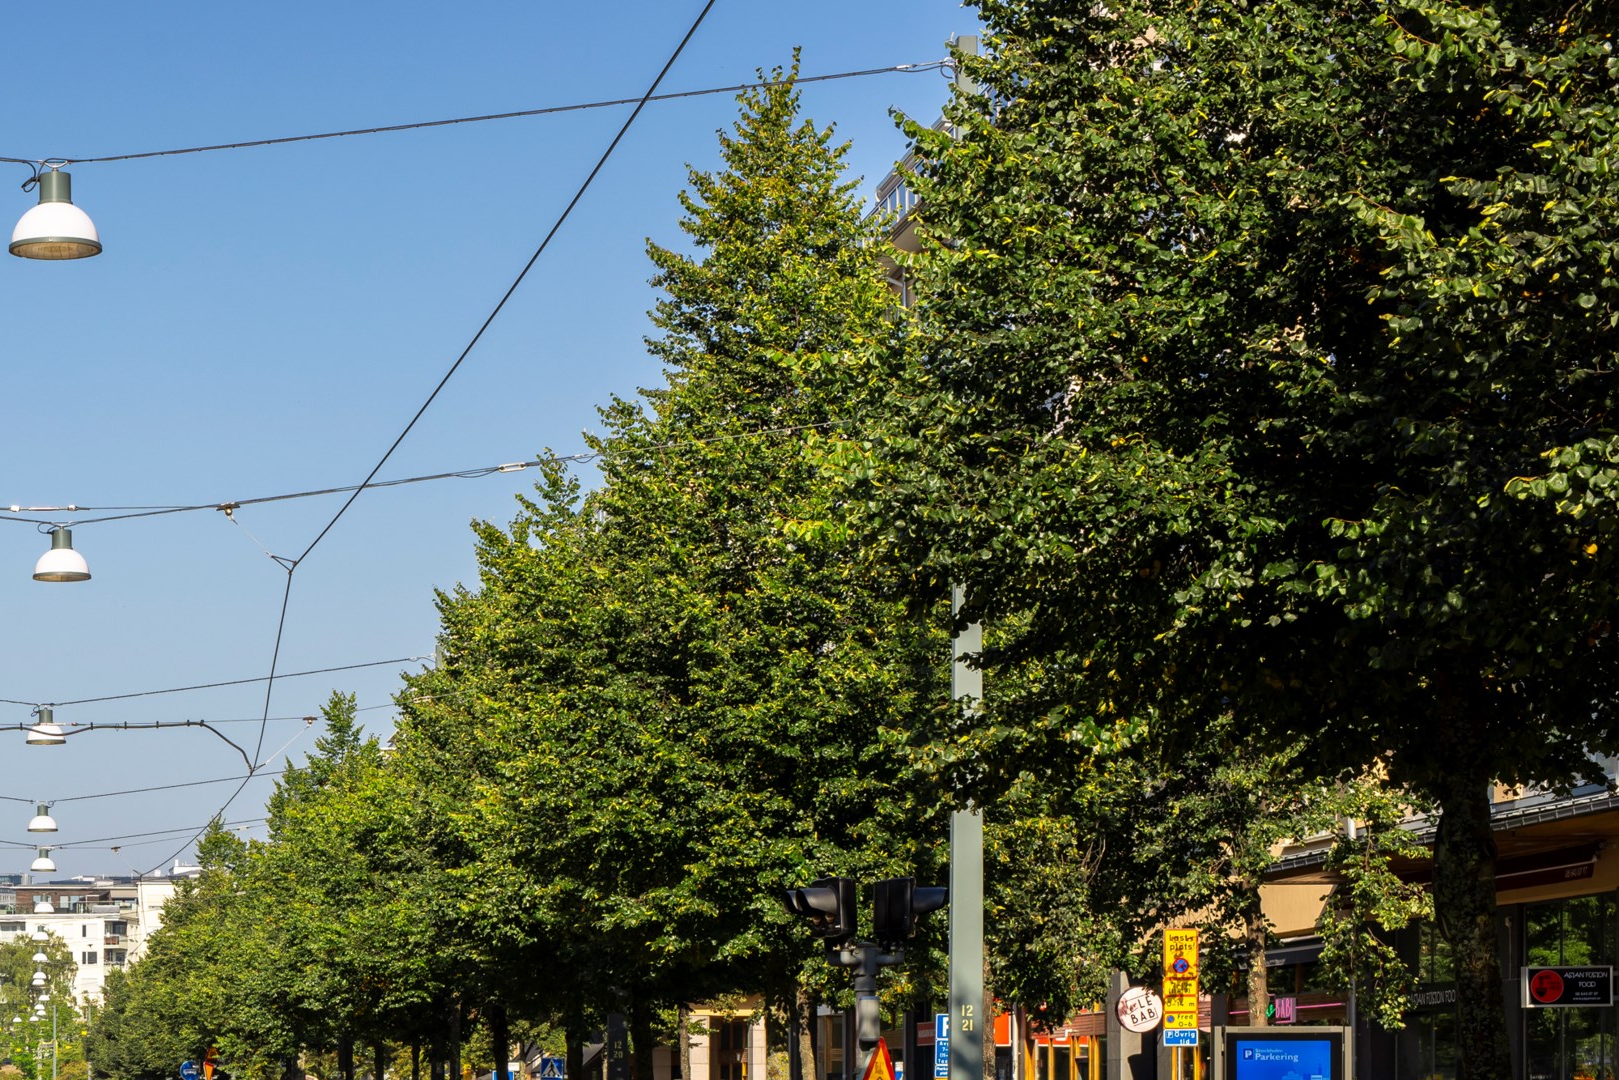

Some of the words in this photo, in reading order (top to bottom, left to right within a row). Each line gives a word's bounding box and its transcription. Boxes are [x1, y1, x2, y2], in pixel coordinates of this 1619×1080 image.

[961, 1005, 973, 1017] 12
[1275, 998, 1291, 1019] BAB
[1131, 1009, 1156, 1024] BAB
[962, 1019, 973, 1031] 21
[1255, 1053, 1299, 1063] Parkering
